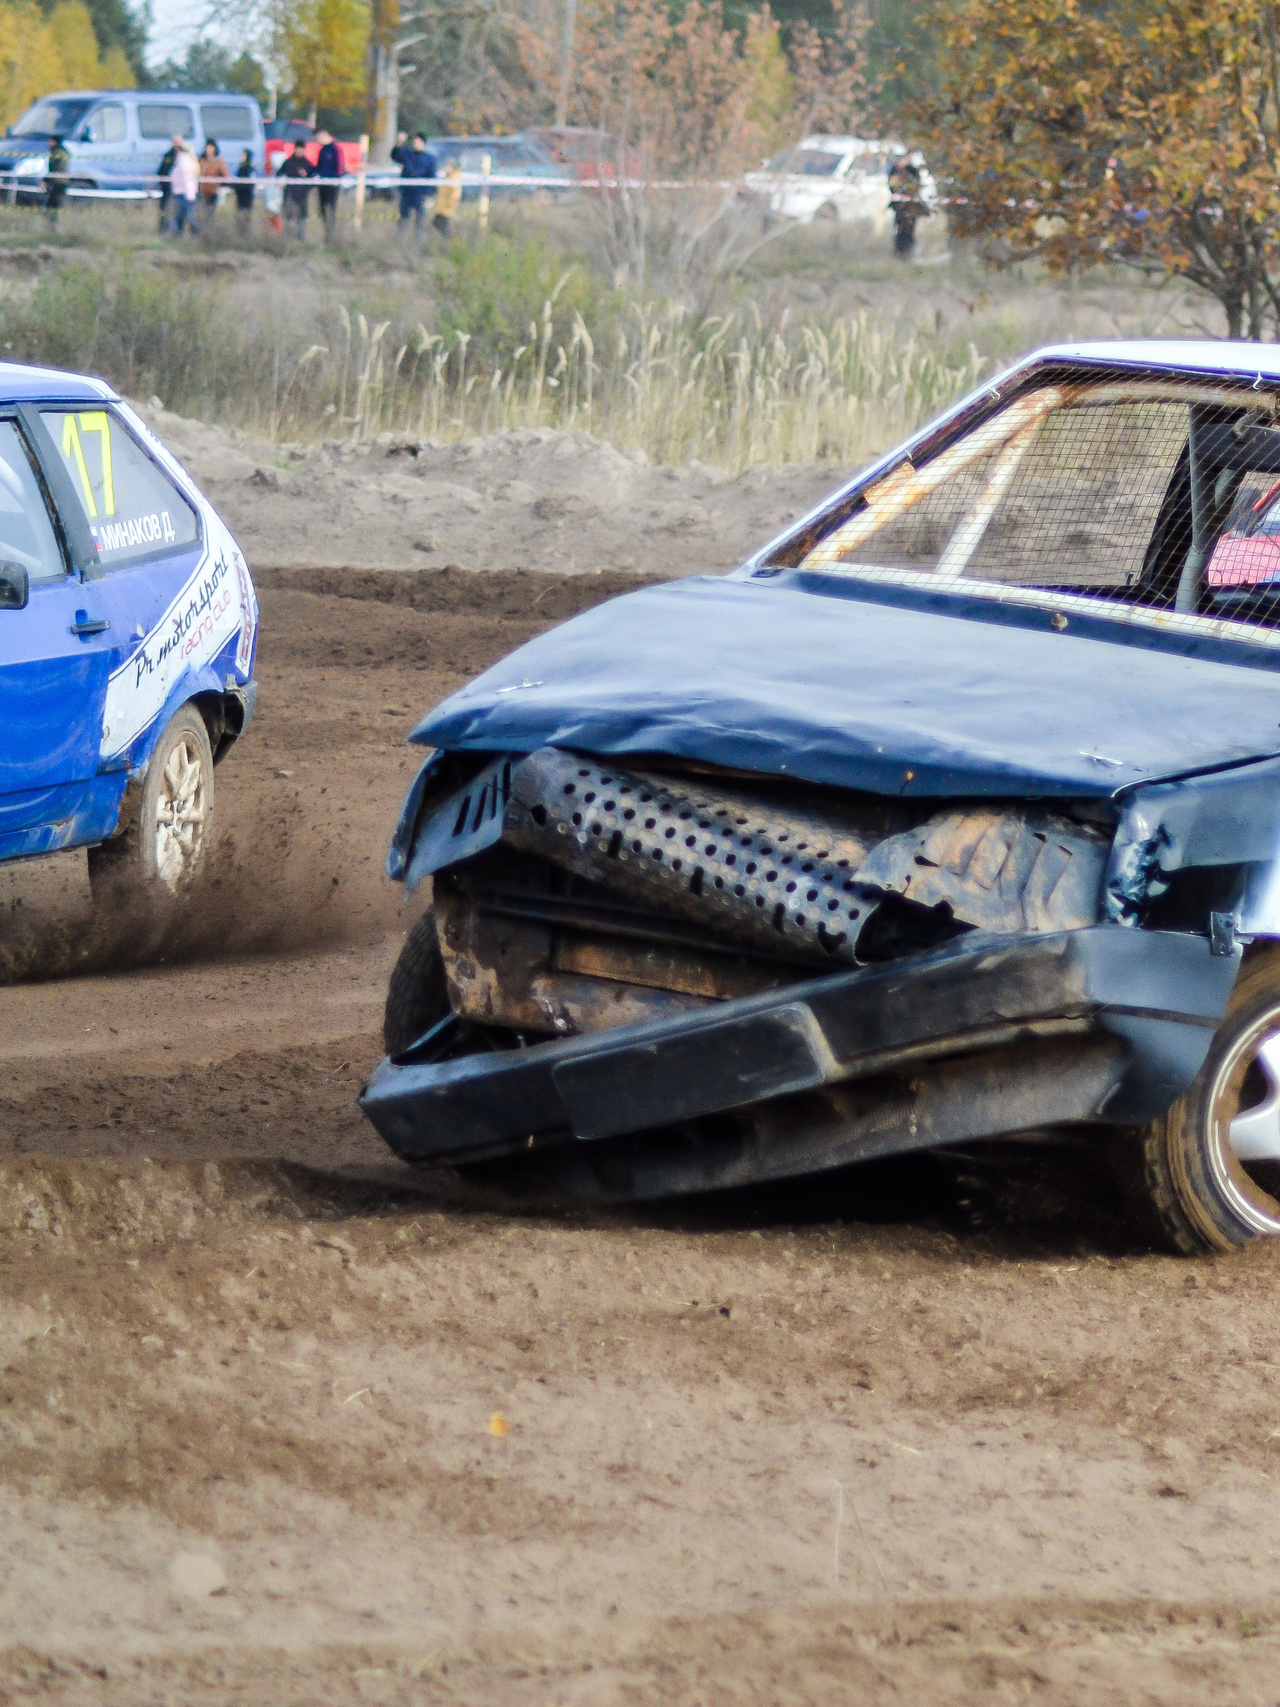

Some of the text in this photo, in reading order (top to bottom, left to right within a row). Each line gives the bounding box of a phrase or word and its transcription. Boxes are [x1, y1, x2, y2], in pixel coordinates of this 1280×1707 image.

[62, 411, 115, 518] 17
[100, 514, 162, 551] МИНАКОВ
[157, 547, 228, 667] motorsport
